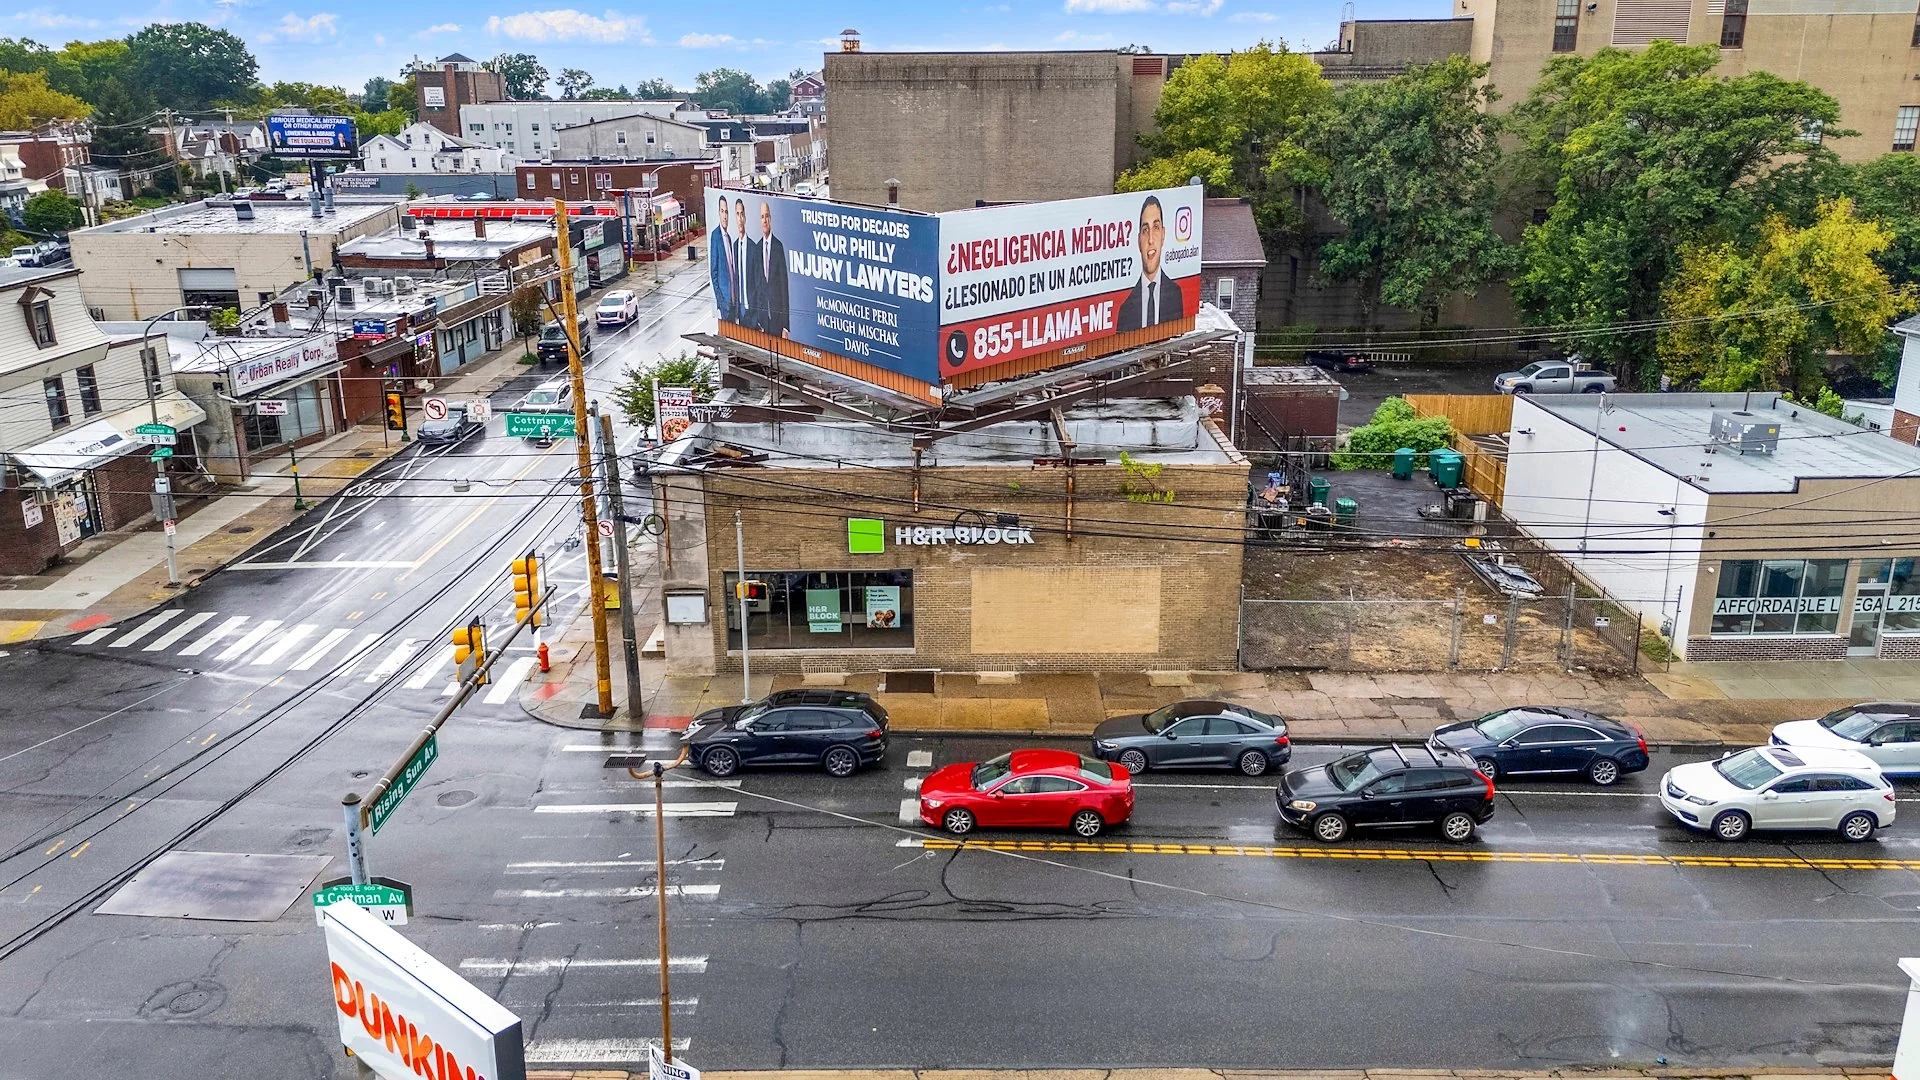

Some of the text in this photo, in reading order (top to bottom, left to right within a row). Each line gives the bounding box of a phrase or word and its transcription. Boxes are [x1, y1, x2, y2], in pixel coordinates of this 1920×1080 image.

[801, 209, 910, 239] TRUSTED FOR DECADES
[812, 231, 896, 263] YOUR PHILLY
[947, 219, 1132, 275] ¿NEGLIGENCIA MÉDICA?
[1165, 245, 1199, 264] @abogado.alan
[789, 250, 934, 303] INJURY LAWYERS
[945, 257, 1133, 310] ¿LESIONADO EN UN ACCIDENTE?
[816, 296, 898, 327] McMONAGLE PERRI
[858, 323, 899, 347] MISCHAK
[973, 300, 1114, 360] 855-LLAMA-ME
[844, 338, 870, 357] DAVIS
[249, 364, 274, 382] Urban
[275, 353, 300, 373] Realty
[659, 399, 691, 407] PIZZA
[514, 416, 557, 425] Cottman
[895, 525, 1035, 545] H&R BLOCK
[809, 605, 828, 613] H&R
[809, 612, 839, 620] BLOCK
[1717, 598, 1826, 613] AFFORDABLE
[374, 744, 434, 822] Rising Sun Av
[327, 892, 403, 904] Cottman Av
[382, 909, 395, 921] W
[331, 961, 484, 1080] DUNKI
